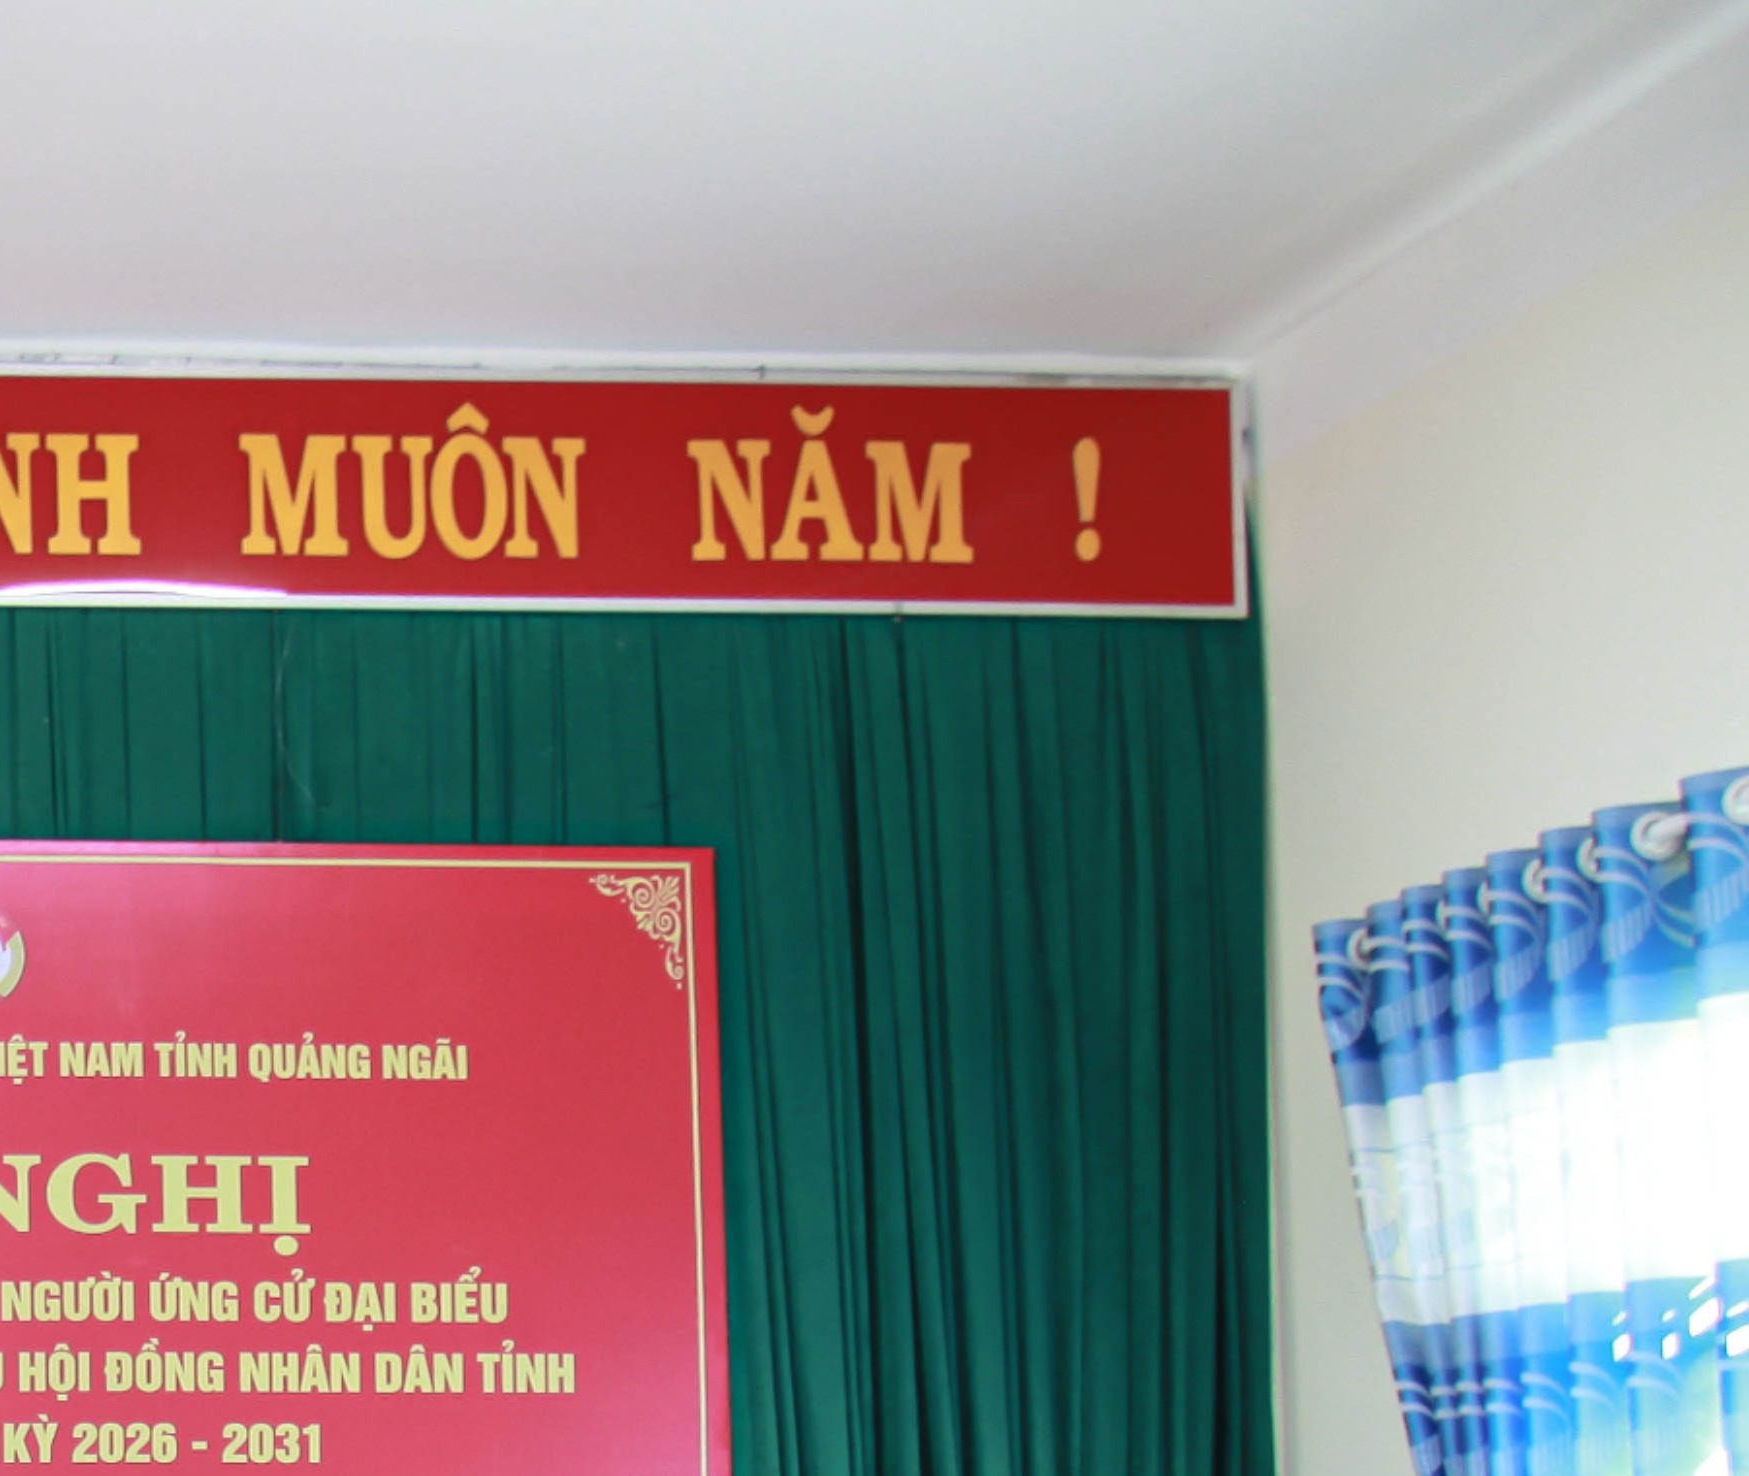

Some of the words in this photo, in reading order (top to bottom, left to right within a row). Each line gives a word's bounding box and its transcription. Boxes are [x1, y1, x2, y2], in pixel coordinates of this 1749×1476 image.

[239, 403, 585, 559] MUÔN
[688, 407, 972, 562] NĂM
[1074, 439, 1098, 560] !
[60, 1042, 143, 1077] NAM
[154, 1031, 237, 1077] TỈNH
[249, 1032, 370, 1082] QUẢNG
[382, 1039, 467, 1079] NGÃI
[1, 1271, 134, 1321] NGƯỜI
[150, 1273, 238, 1321] ỨNG
[254, 1268, 315, 1322] CỬ
[324, 1282, 396, 1331] ĐẠI
[411, 1266, 507, 1323] BIỂU
[19, 1344, 90, 1401] HỘI
[104, 1338, 224, 1392] ĐỒNG
[240, 1344, 360, 1392] NHÂN
[375, 1344, 463, 1393] DÂN
[477, 1340, 574, 1393] TỈNH
[4, 1414, 58, 1463] KỲ
[72, 1423, 177, 1463] 2026
[192, 1441, 207, 1449] -
[222, 1423, 320, 1463] 2031
